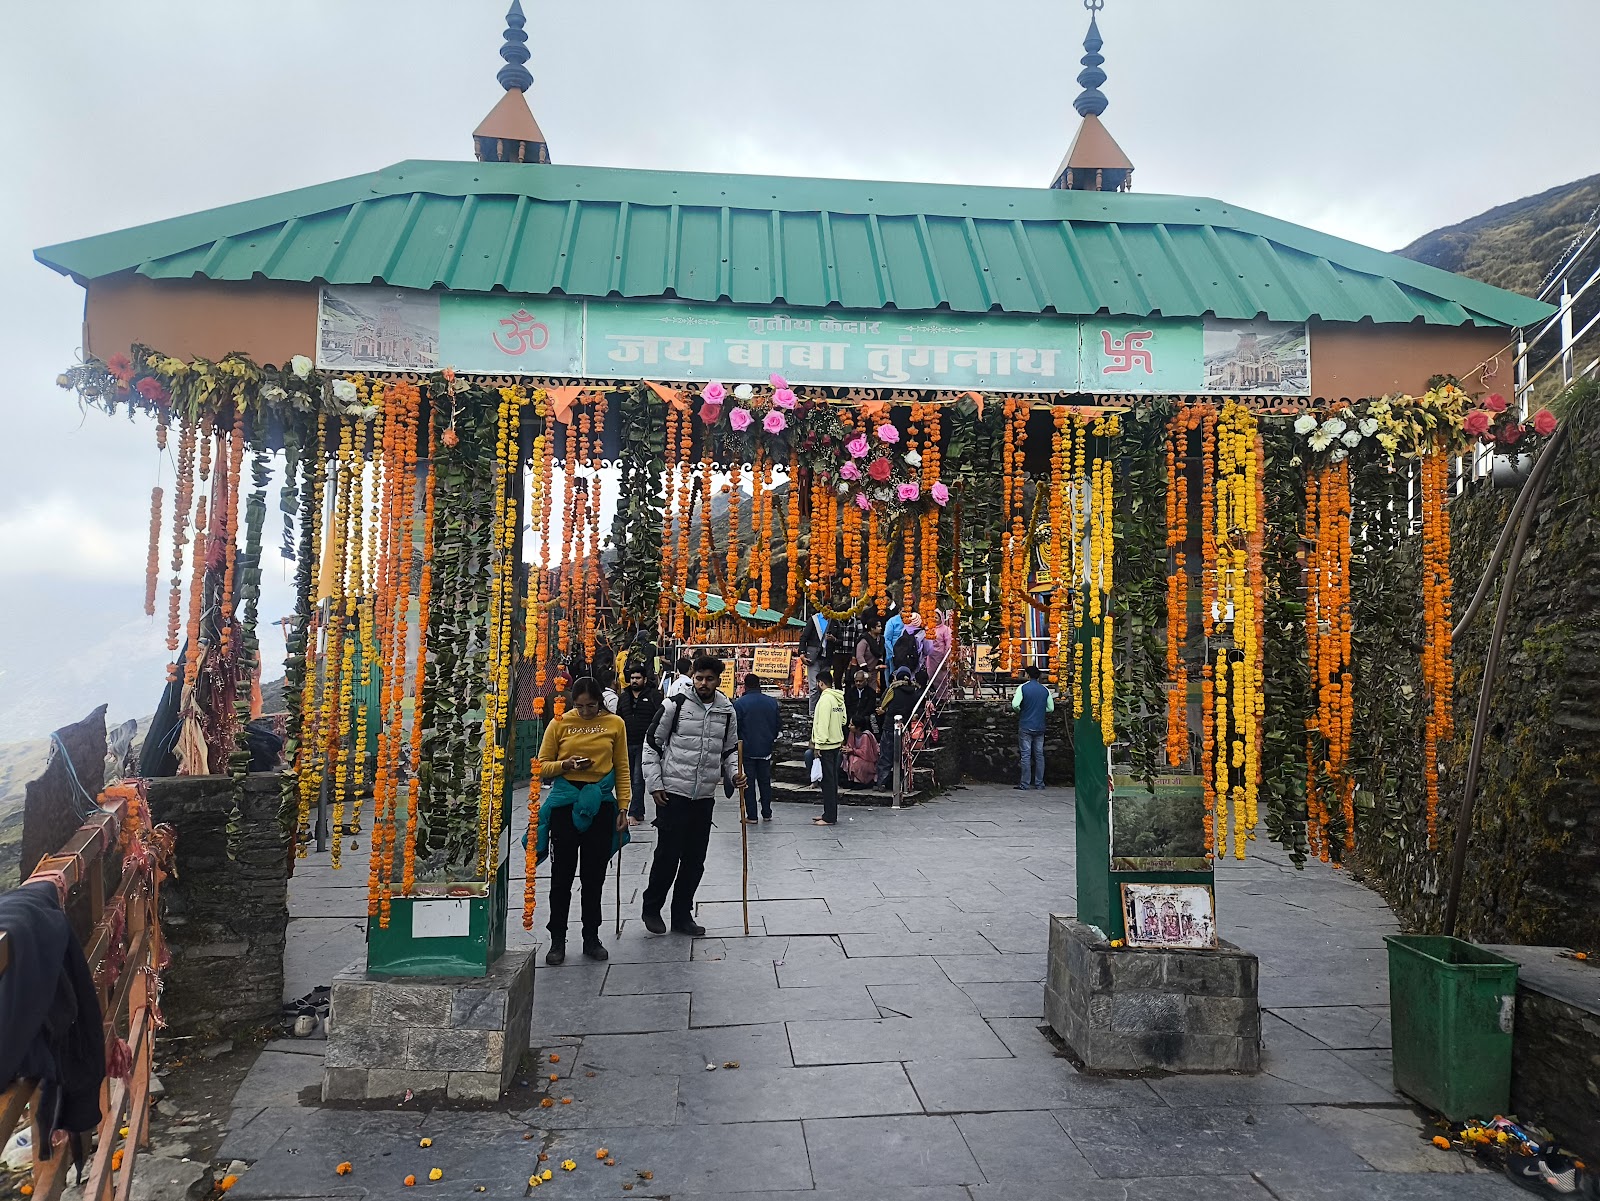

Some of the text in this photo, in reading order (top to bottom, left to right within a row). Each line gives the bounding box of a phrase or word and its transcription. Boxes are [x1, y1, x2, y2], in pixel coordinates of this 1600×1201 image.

[747, 314, 882, 335] तृतीय केदार
[605, 335, 1061, 383] जय बाबा तुंगनाथ
